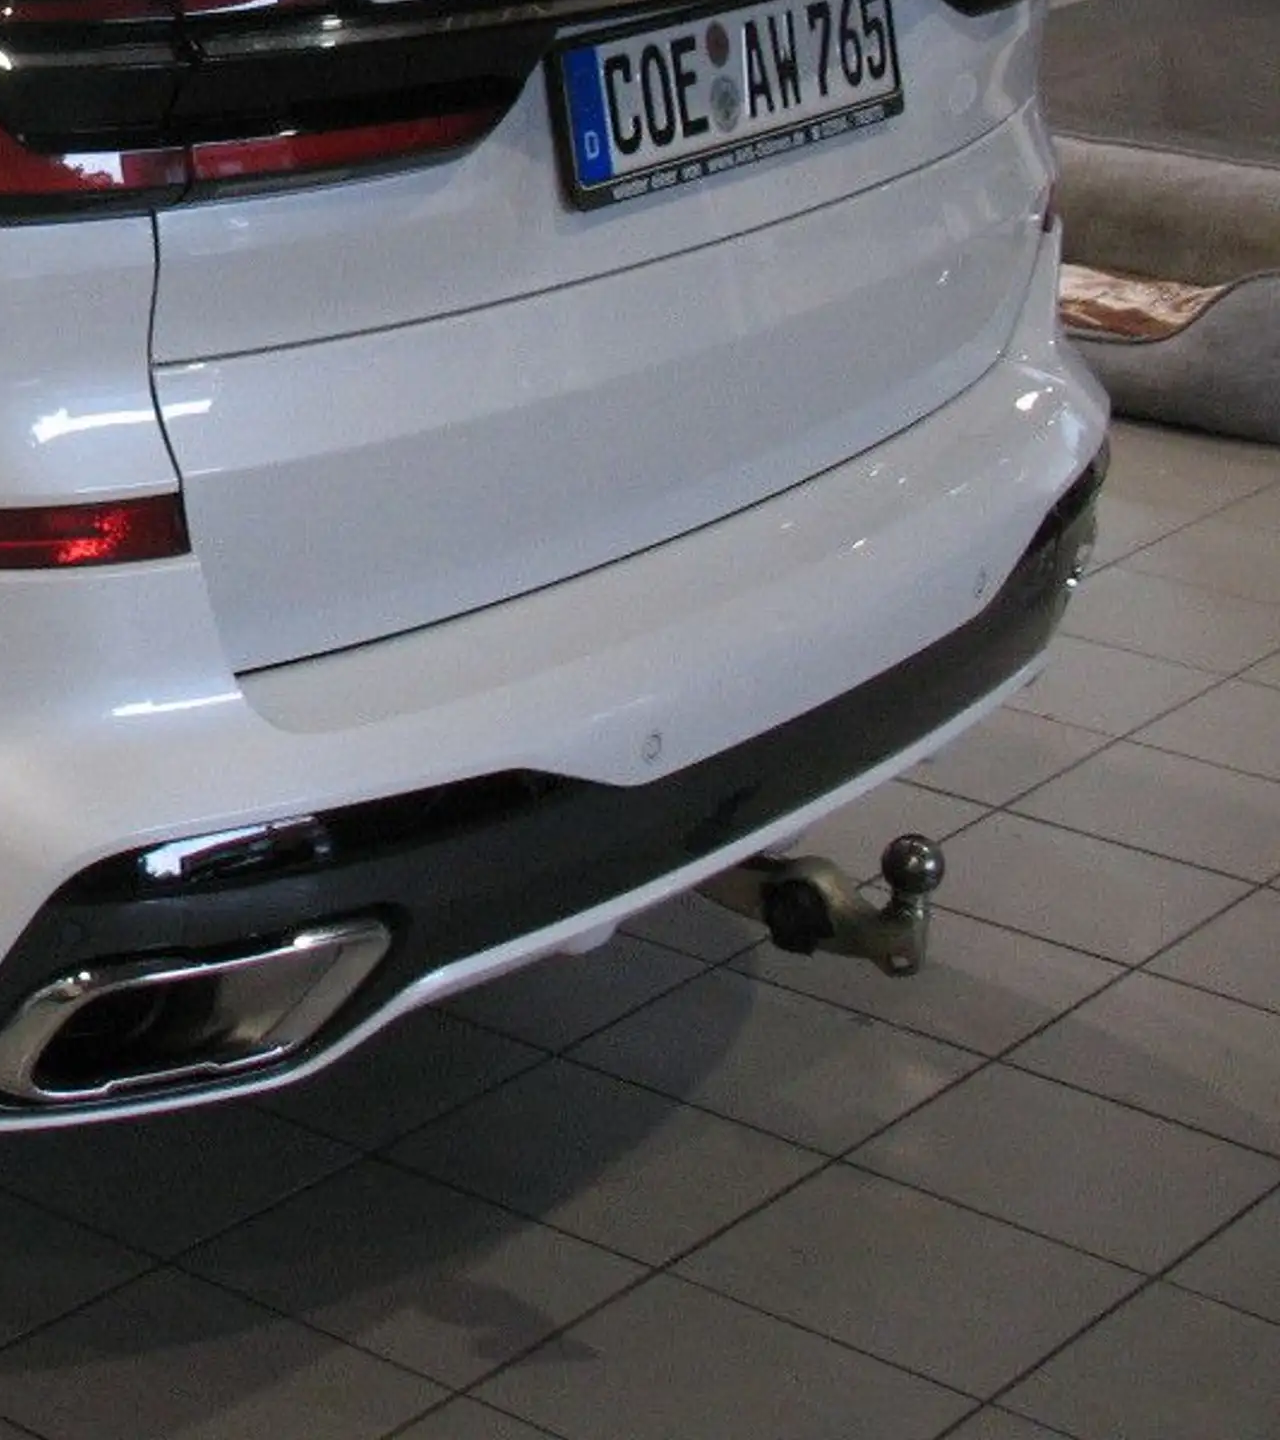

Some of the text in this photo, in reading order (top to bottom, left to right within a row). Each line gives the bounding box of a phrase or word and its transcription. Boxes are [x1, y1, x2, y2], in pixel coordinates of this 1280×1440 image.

[604, 35, 710, 155] COE
[742, 8, 803, 118] AW
[584, 129, 601, 160] D
